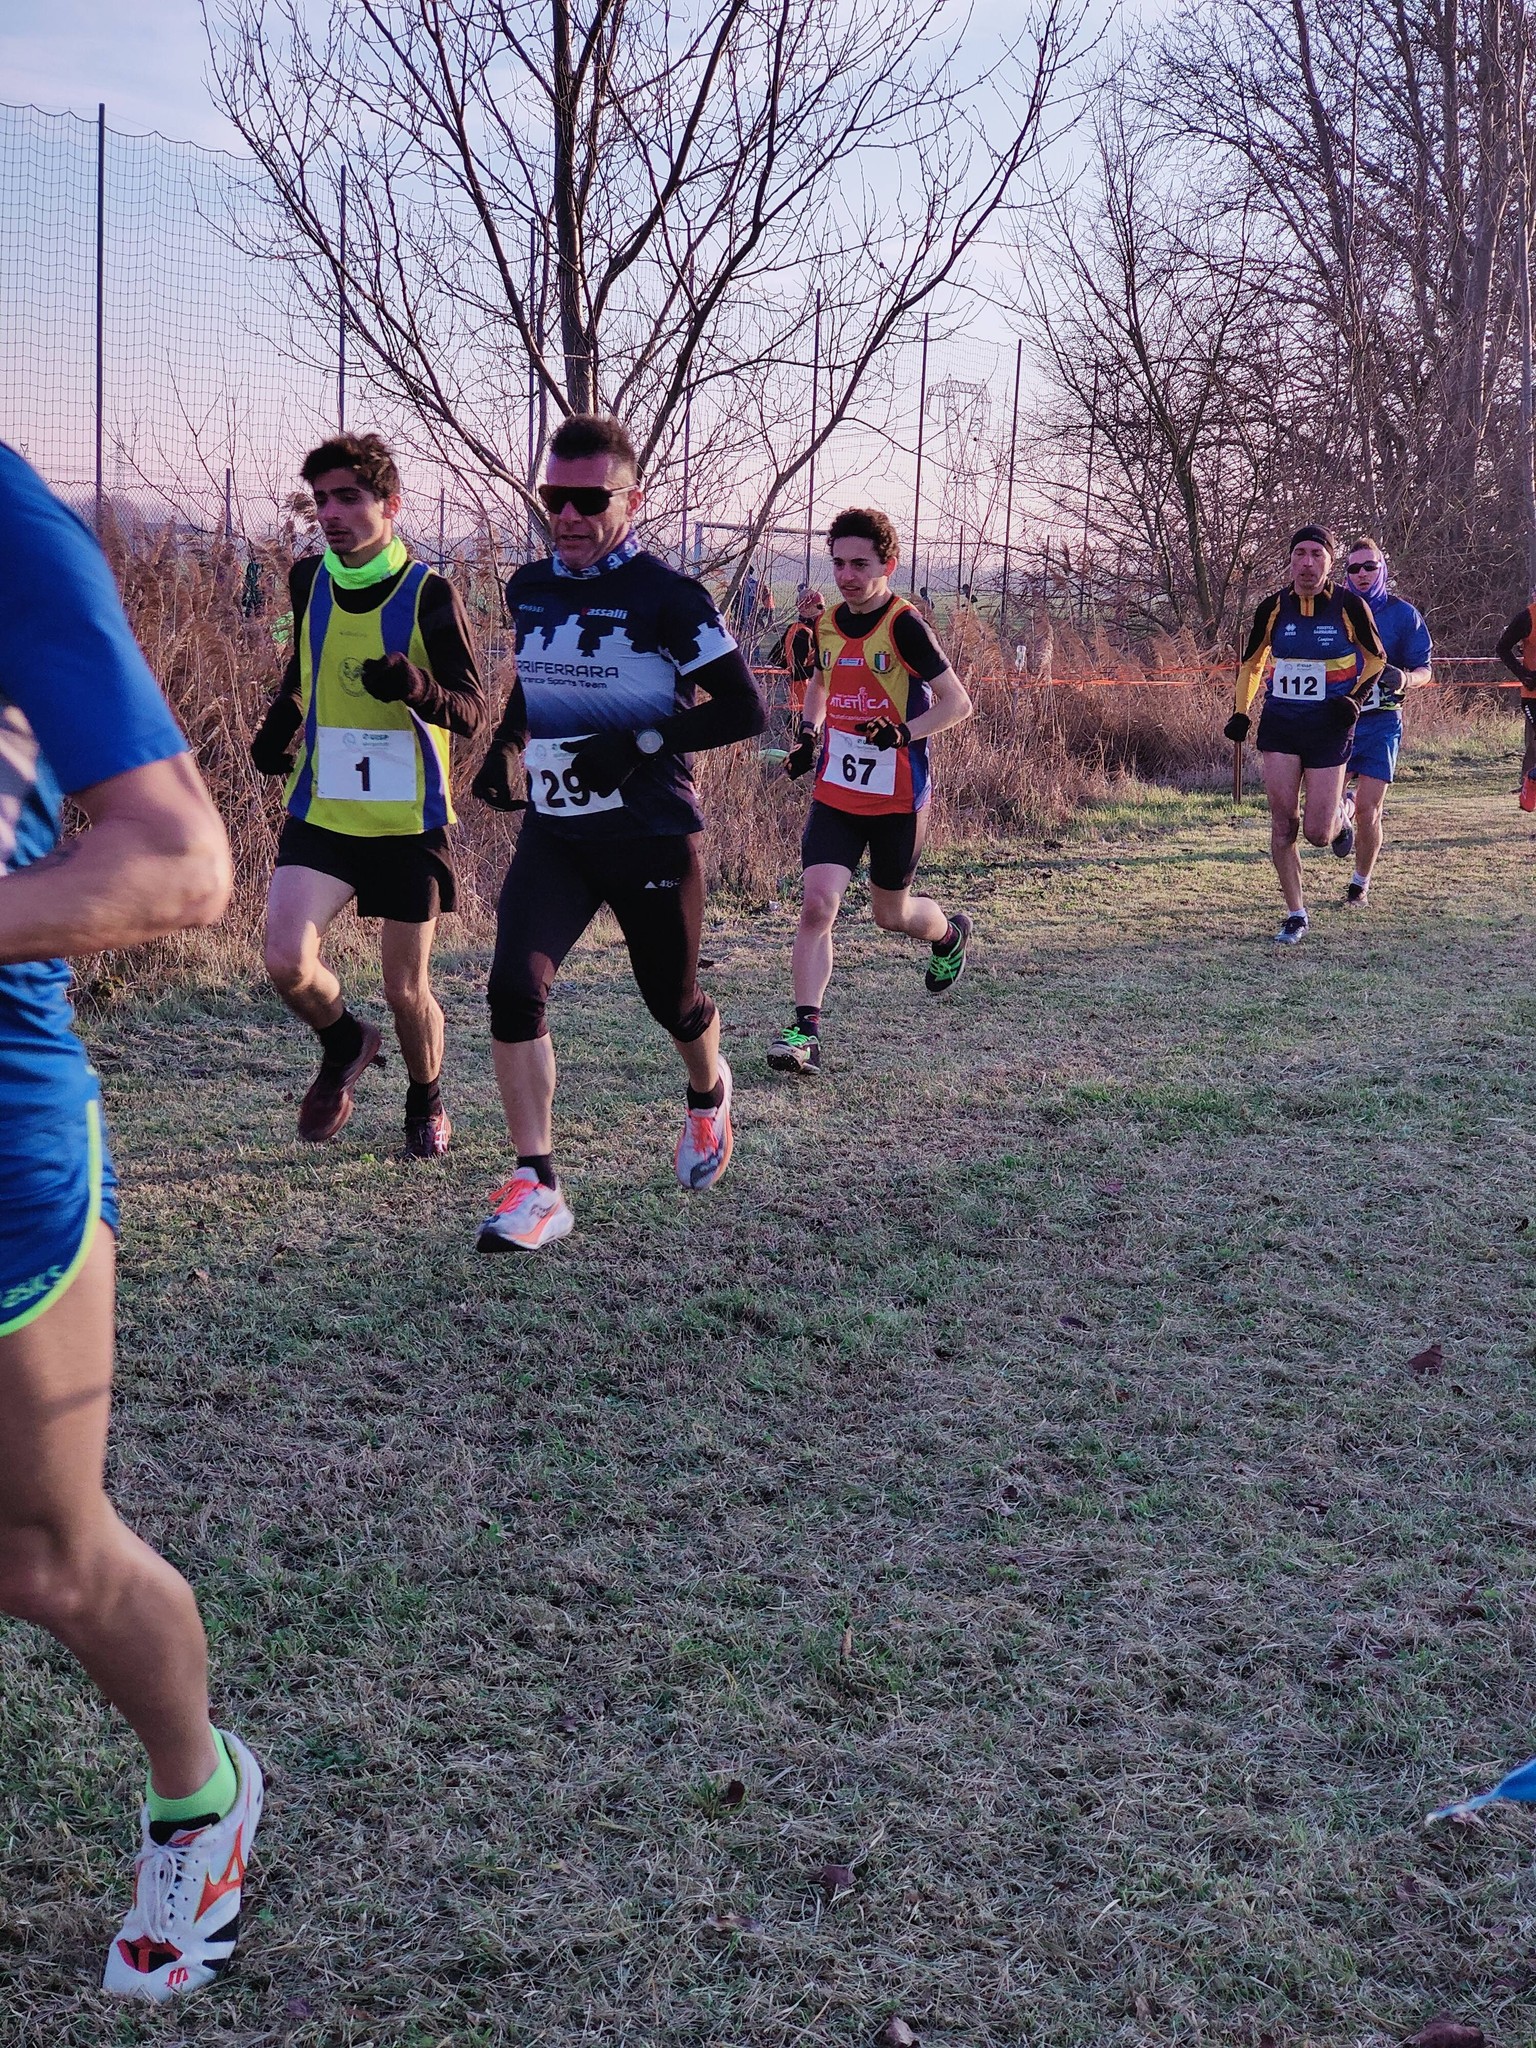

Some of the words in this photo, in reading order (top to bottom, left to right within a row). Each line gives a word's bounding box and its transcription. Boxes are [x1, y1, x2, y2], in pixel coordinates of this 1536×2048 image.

[547, 677, 577, 688] Sports
[580, 680, 608, 689] Team
[1279, 675, 1318, 696] 112
[355, 756, 371, 792] 1
[842, 753, 877, 786] 67
